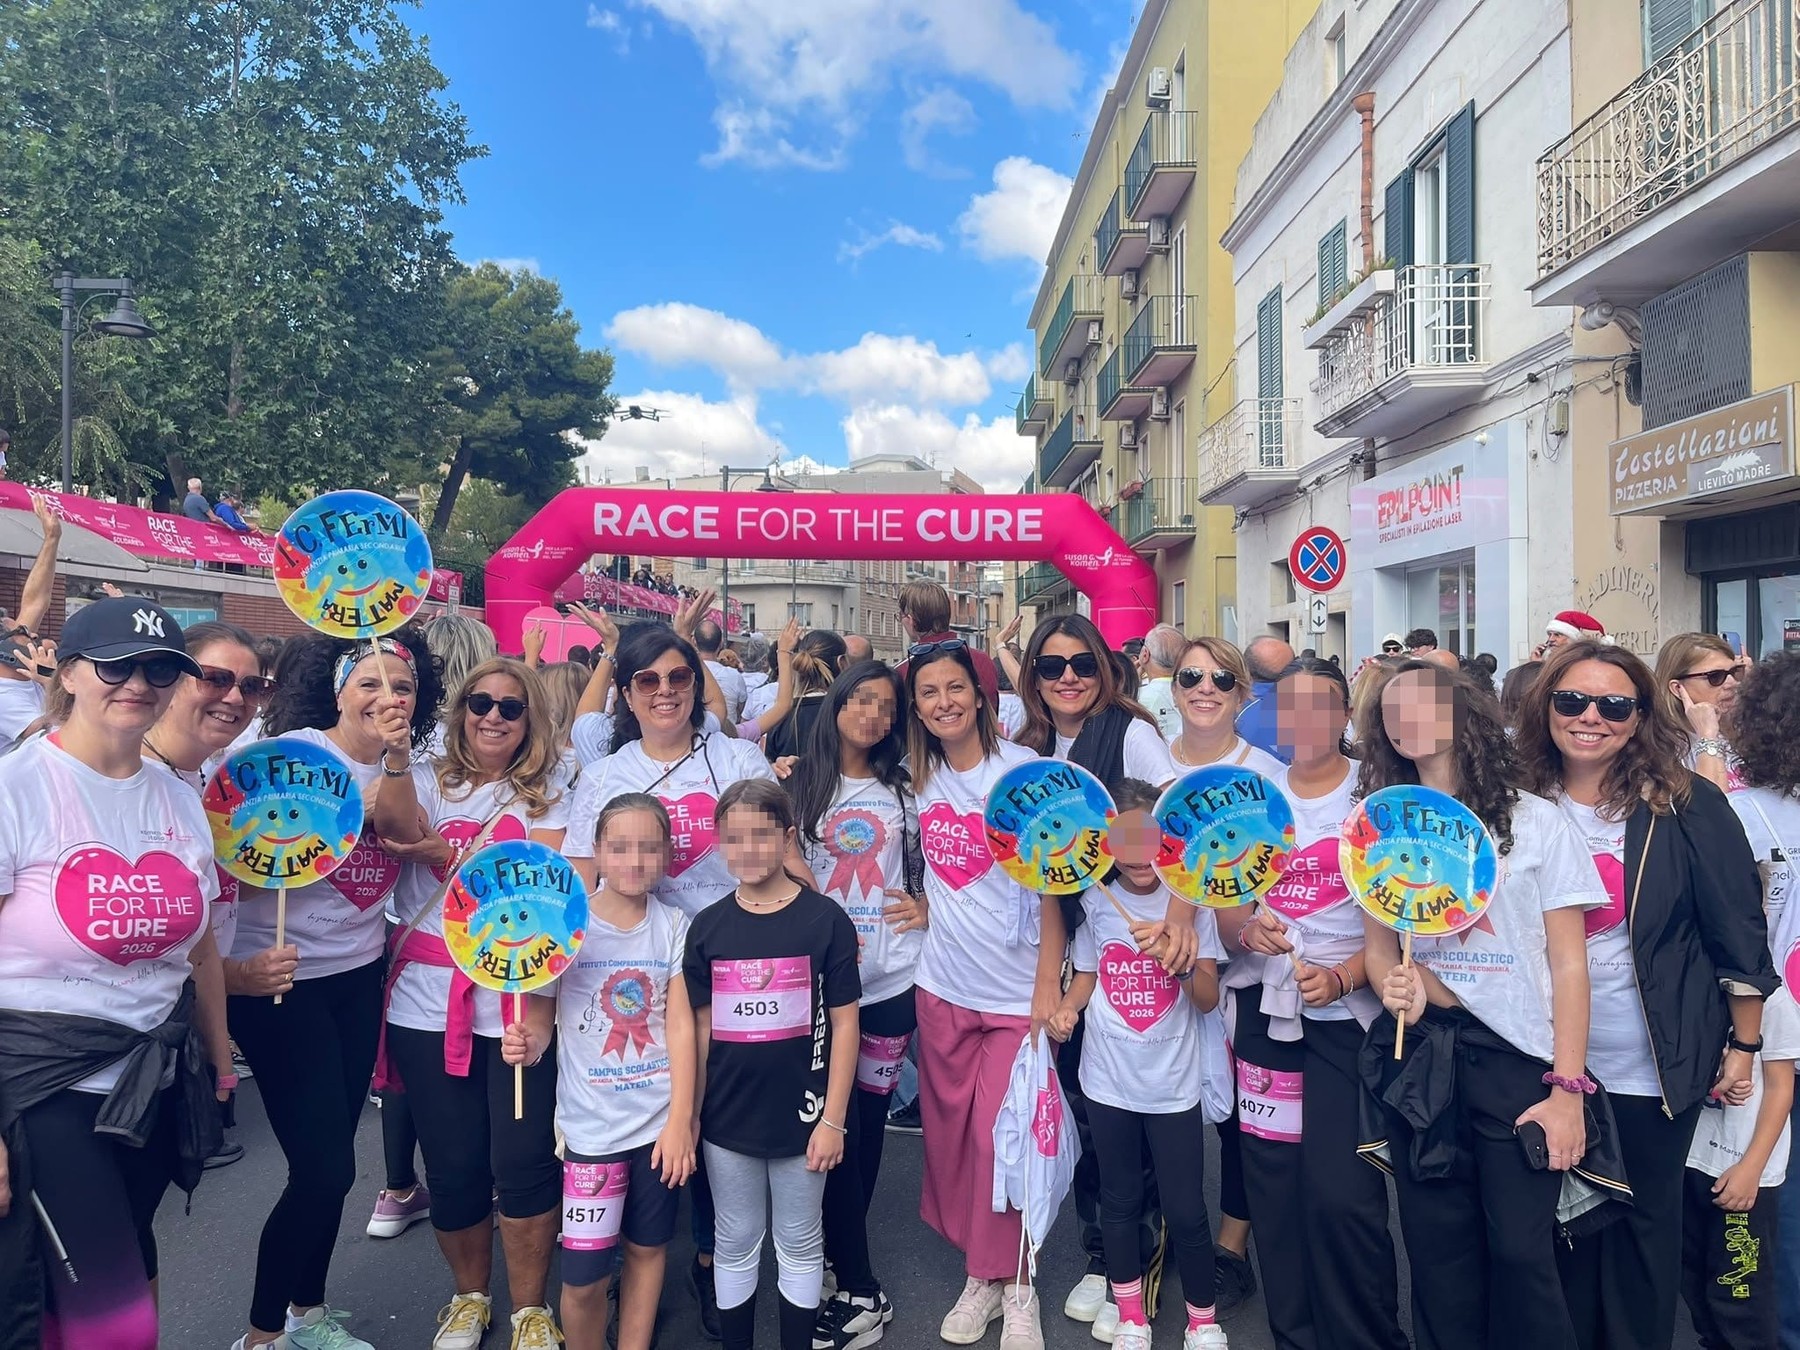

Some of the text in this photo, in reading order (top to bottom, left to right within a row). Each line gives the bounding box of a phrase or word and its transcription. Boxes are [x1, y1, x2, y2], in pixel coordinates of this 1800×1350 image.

[1615, 406, 1778, 482] Costellazioni
[1699, 464, 1772, 491] LIEVITO MADRE
[1616, 475, 1677, 504] PIZZERIA
[147, 516, 177, 534] RACE
[593, 502, 1043, 543] RACE FOR THE CURE
[1379, 512, 1462, 544] SPECIALISTI IN EPILAZIONE LASER
[151, 531, 174, 547] FOR
[175, 537, 197, 550] THE
[259, 550, 276, 565] CU
[322, 582, 405, 628] MATERA
[666, 805, 689, 818] CE
[678, 817, 714, 832] THE
[928, 820, 969, 839] RACE
[672, 833, 692, 849] RE
[926, 834, 985, 858] FOR THE
[239, 839, 328, 878] MATERA
[351, 851, 375, 866] OR
[673, 853, 687, 861] 26
[927, 849, 966, 869] CURE
[1042, 830, 1100, 885] MATERA
[335, 868, 386, 883] CURE
[1203, 844, 1274, 899] MATERA
[1281, 872, 1343, 887] OR THE
[1768, 870, 1790, 880] nel
[88, 873, 164, 894] RACE
[355, 887, 379, 897] 2026
[1268, 884, 1320, 901] CURE
[1372, 876, 1459, 923] MATERA
[89, 897, 195, 916] FOR THE
[87, 918, 168, 941] CURE
[119, 943, 157, 955] 2026
[478, 938, 559, 982] MATERA
[1443, 952, 1514, 964] SCOLASTICO
[1107, 960, 1154, 975] RACE
[1111, 976, 1173, 990] FOR THE
[1110, 991, 1156, 1006] CURE
[733, 1001, 779, 1016] 4503
[1129, 1009, 1155, 1018] 2026
[588, 1066, 623, 1077] CAMPUS
[615, 1079, 654, 1092] MATERA
[1240, 1098, 1276, 1118] 4077
[566, 1207, 607, 1223] 4517
